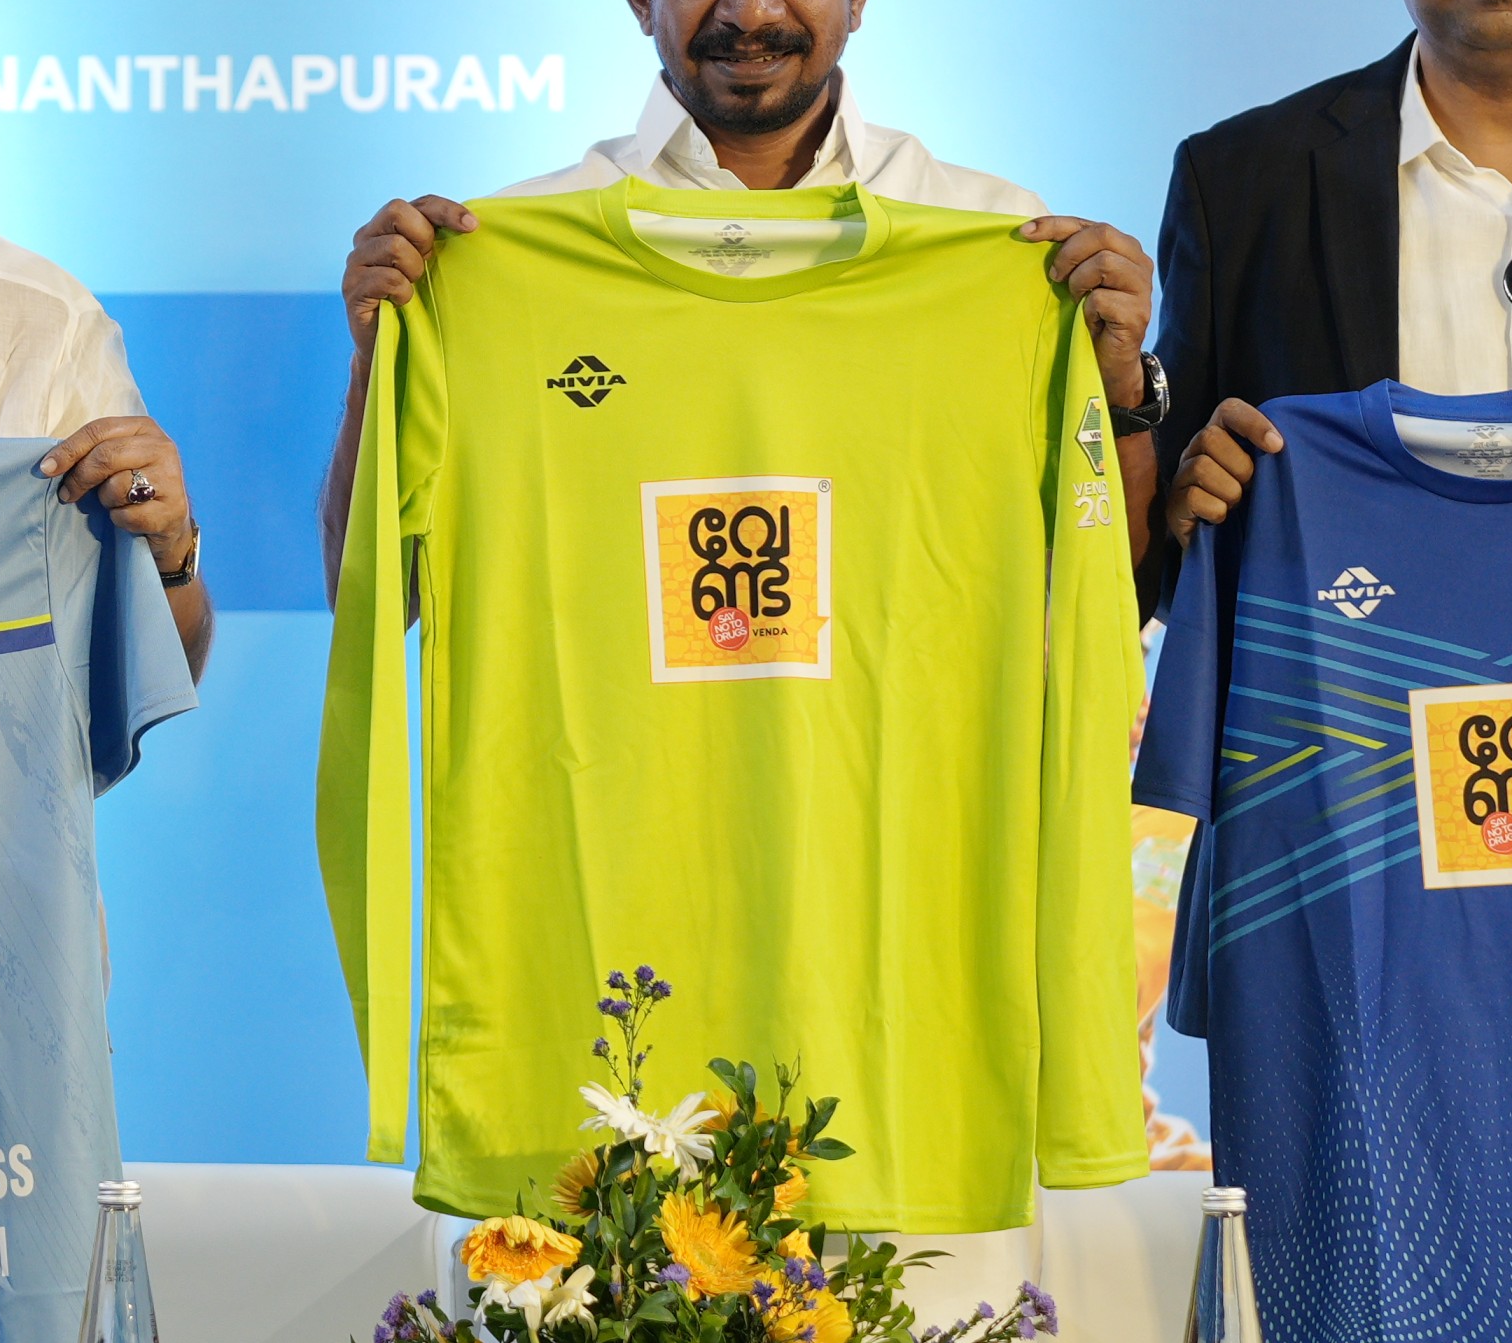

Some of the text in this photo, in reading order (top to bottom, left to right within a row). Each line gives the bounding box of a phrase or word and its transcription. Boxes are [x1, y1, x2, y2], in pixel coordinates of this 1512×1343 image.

[547, 373, 626, 390] NIVIA
[1317, 582, 1396, 603] NIVIA
[718, 611, 736, 624] SAY
[714, 619, 743, 634] NO TO
[752, 627, 789, 637] VENDA
[715, 628, 748, 643] DRUGS
[1490, 816, 1508, 828] SAY
[1487, 826, 1503, 837] NO
